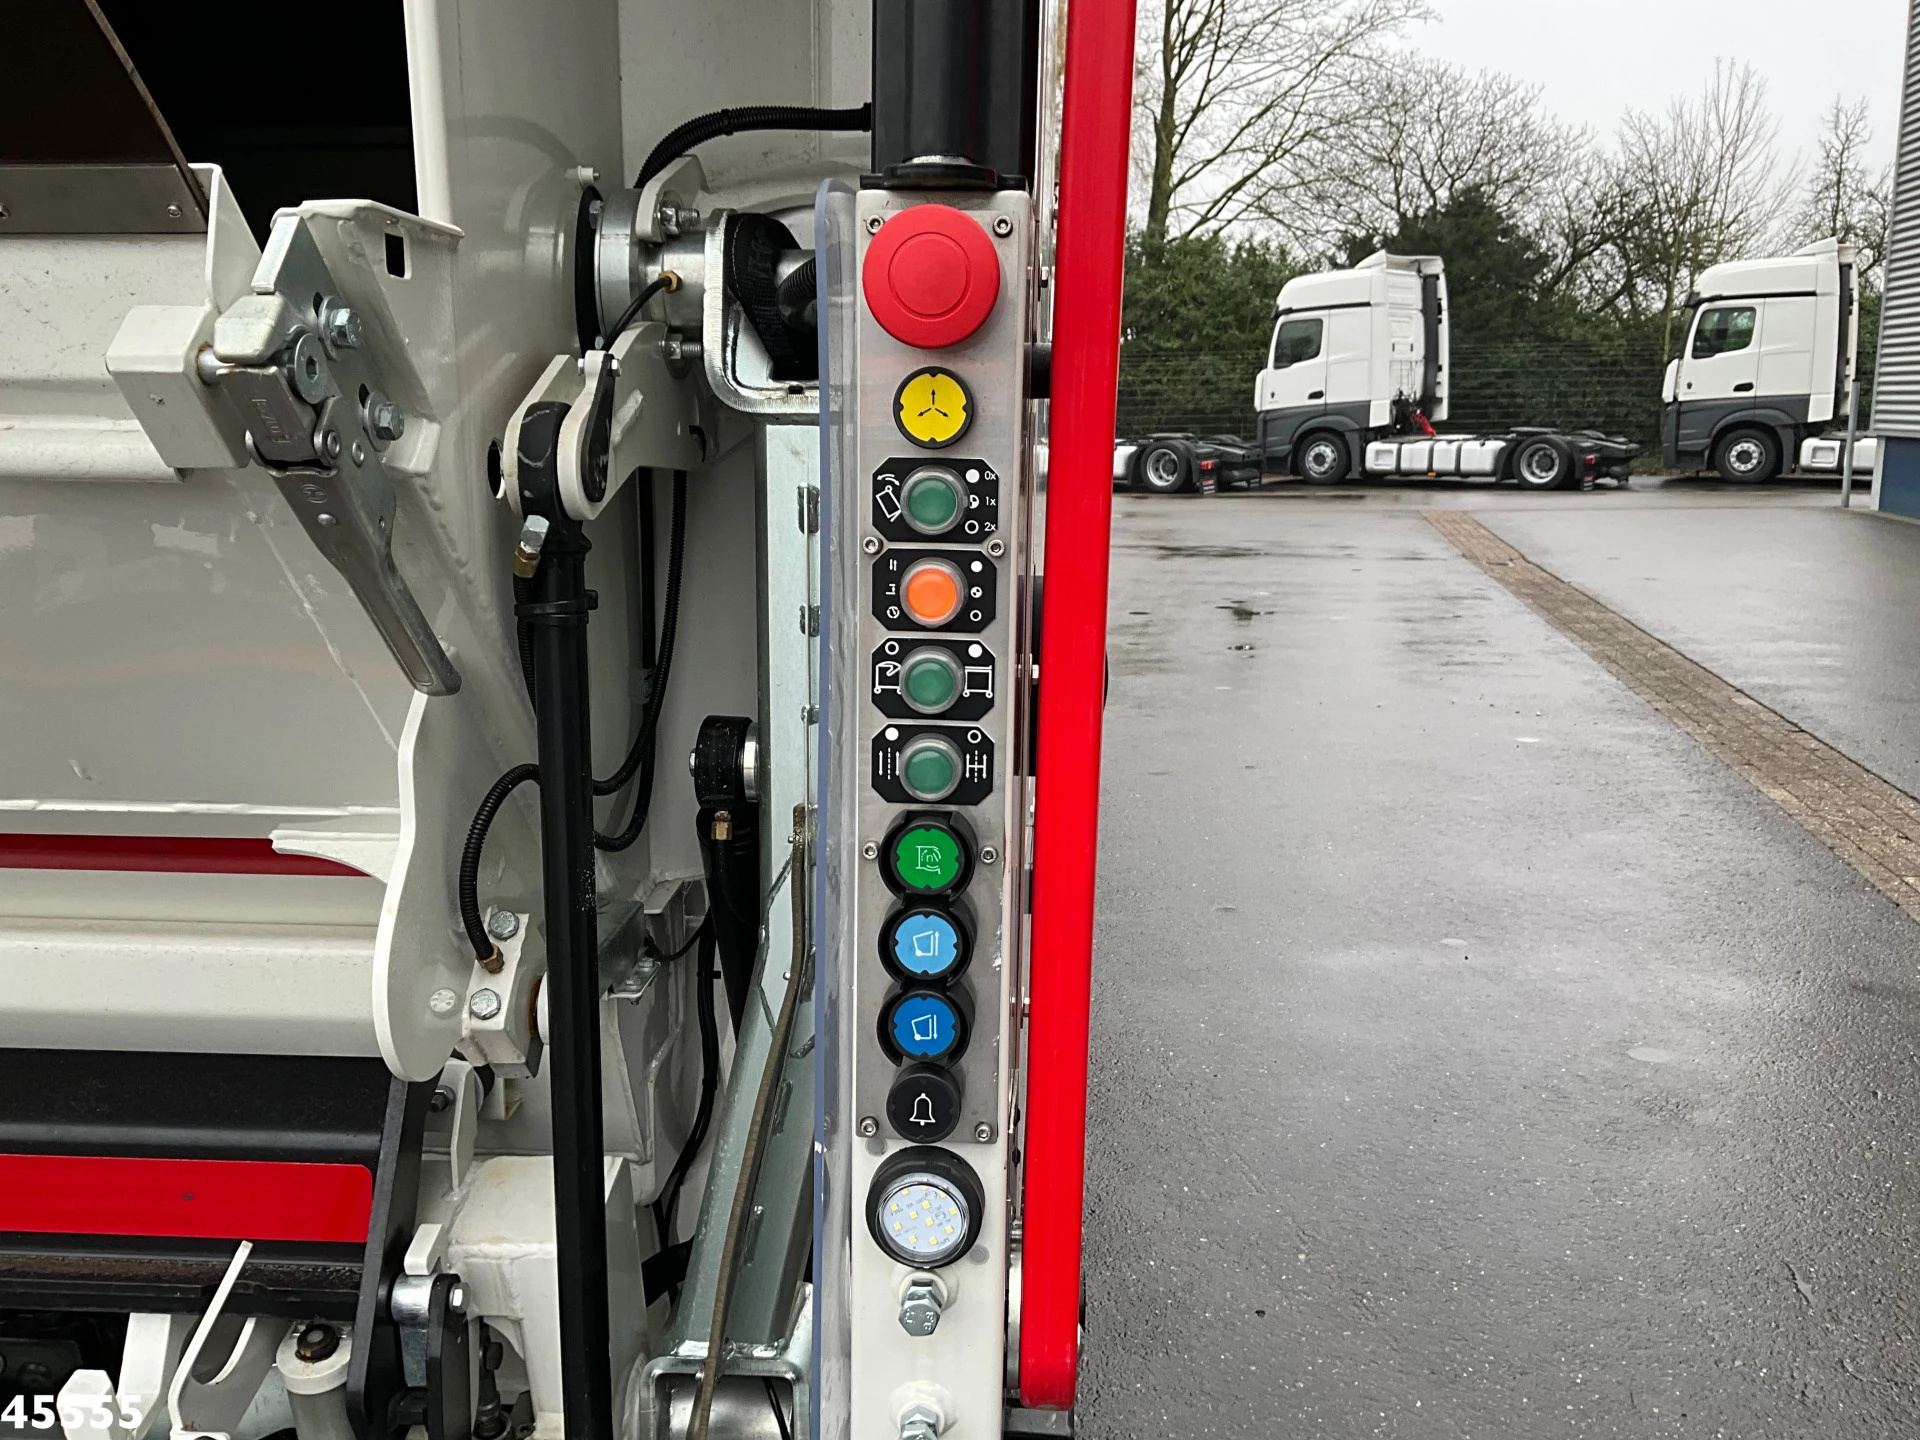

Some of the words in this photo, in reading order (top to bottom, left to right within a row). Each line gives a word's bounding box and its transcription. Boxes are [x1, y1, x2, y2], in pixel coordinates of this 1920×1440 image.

[984, 470, 997, 480] 0x
[985, 496, 997, 506] 1x
[984, 521, 997, 531] 2x
